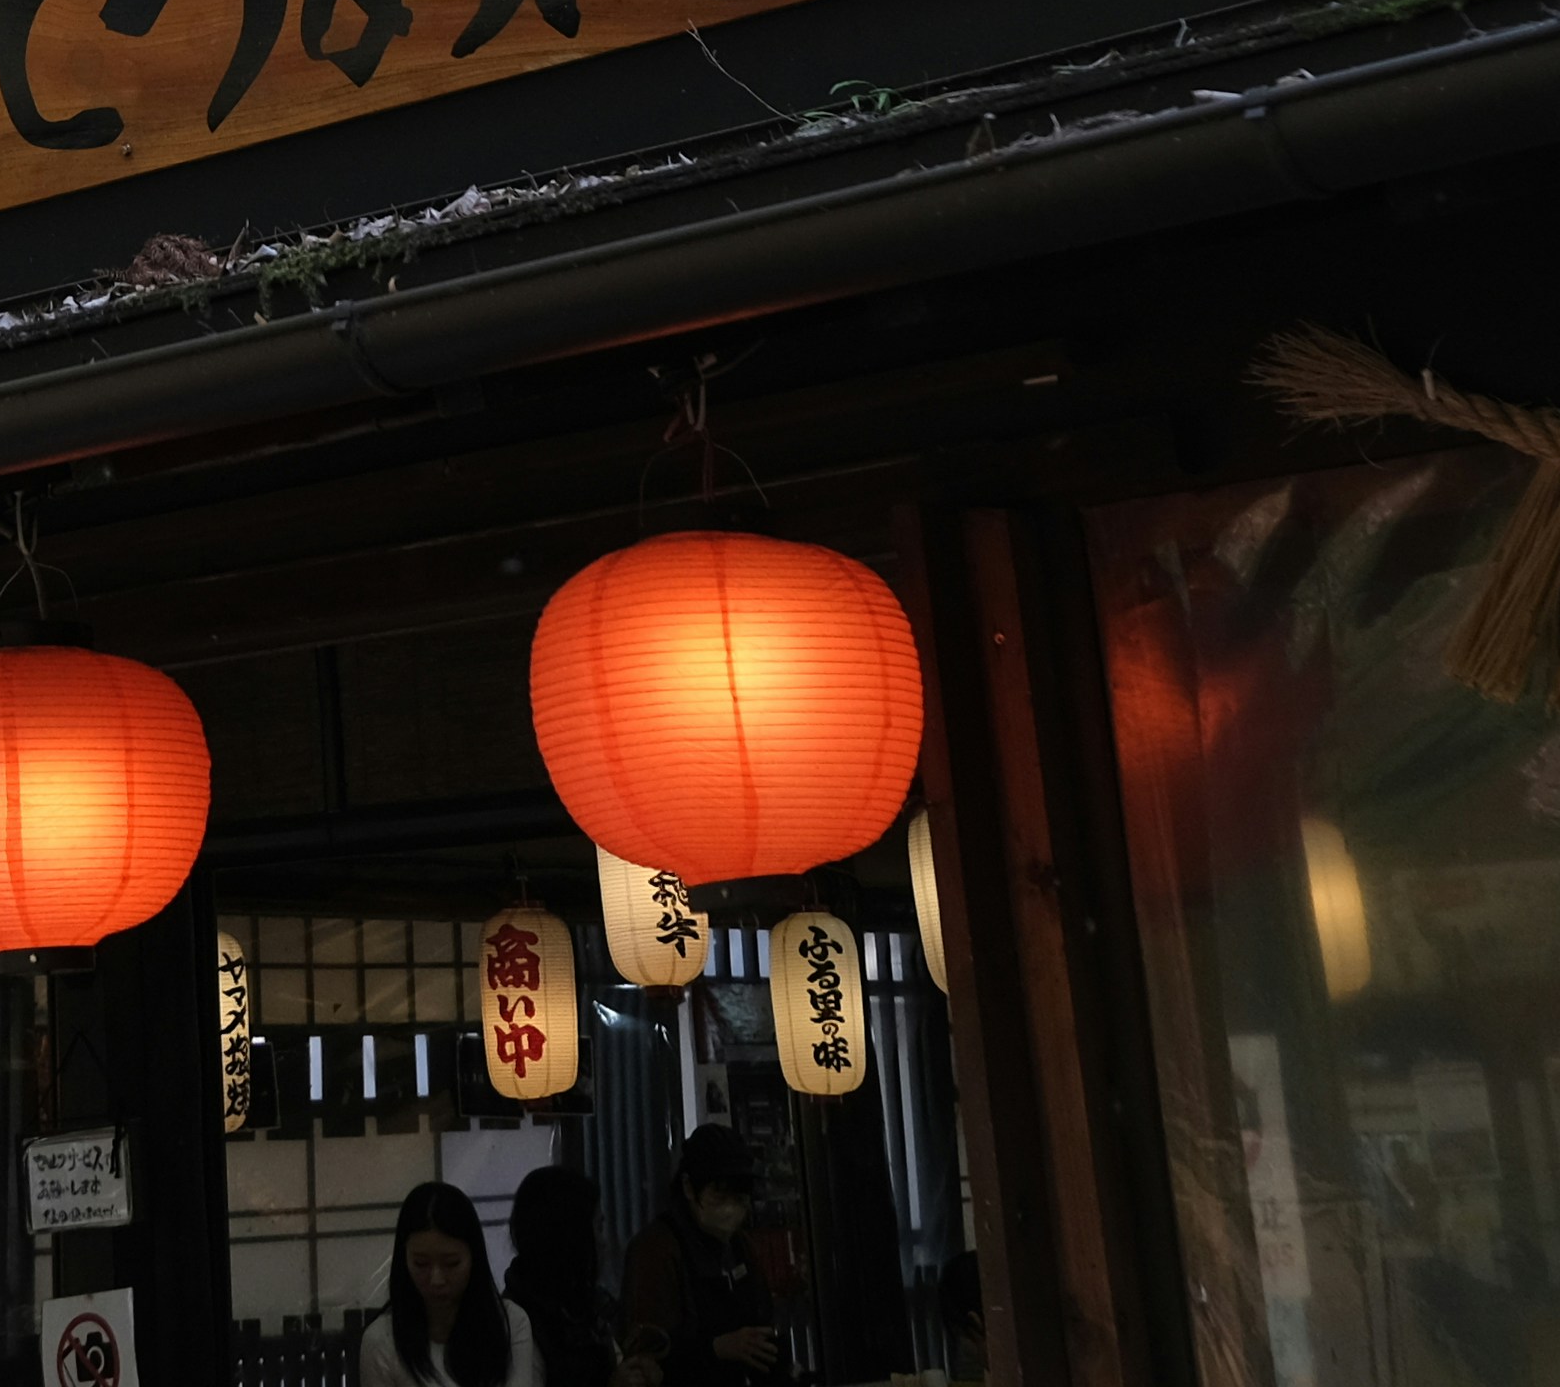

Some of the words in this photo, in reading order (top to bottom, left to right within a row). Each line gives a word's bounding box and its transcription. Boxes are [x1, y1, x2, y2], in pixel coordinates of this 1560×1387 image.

[486, 923, 547, 1078] 商い中
[799, 926, 852, 1073] ふる里の味
